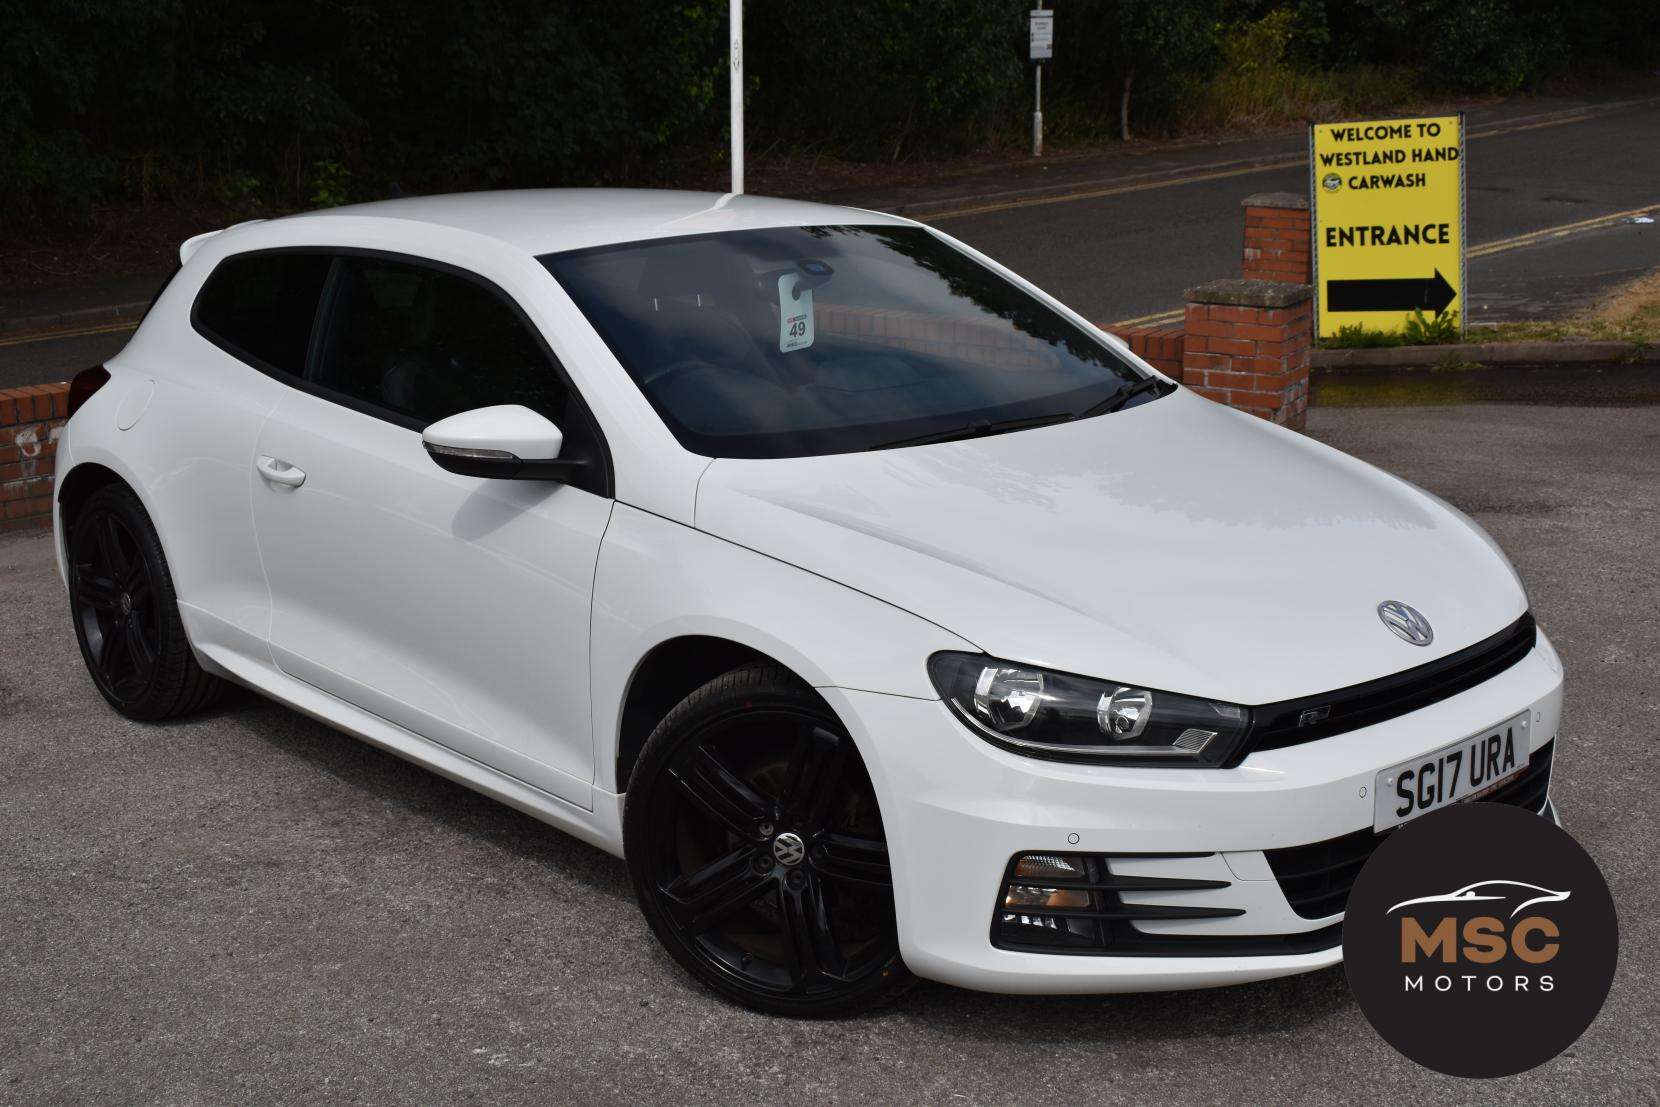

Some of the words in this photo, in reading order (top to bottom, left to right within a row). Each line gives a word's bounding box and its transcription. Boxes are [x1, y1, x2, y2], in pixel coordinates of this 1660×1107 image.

[1330, 124, 1412, 142] WELCOME
[1416, 122, 1441, 138] TO
[1320, 149, 1406, 167] WESTLAND
[1412, 146, 1459, 163] HAND
[1348, 173, 1426, 190] CARWASH
[1326, 223, 1450, 247] ENTRANCE
[789, 321, 806, 338] 49
[1396, 750, 1463, 818] SG17
[1469, 727, 1515, 787] URA
